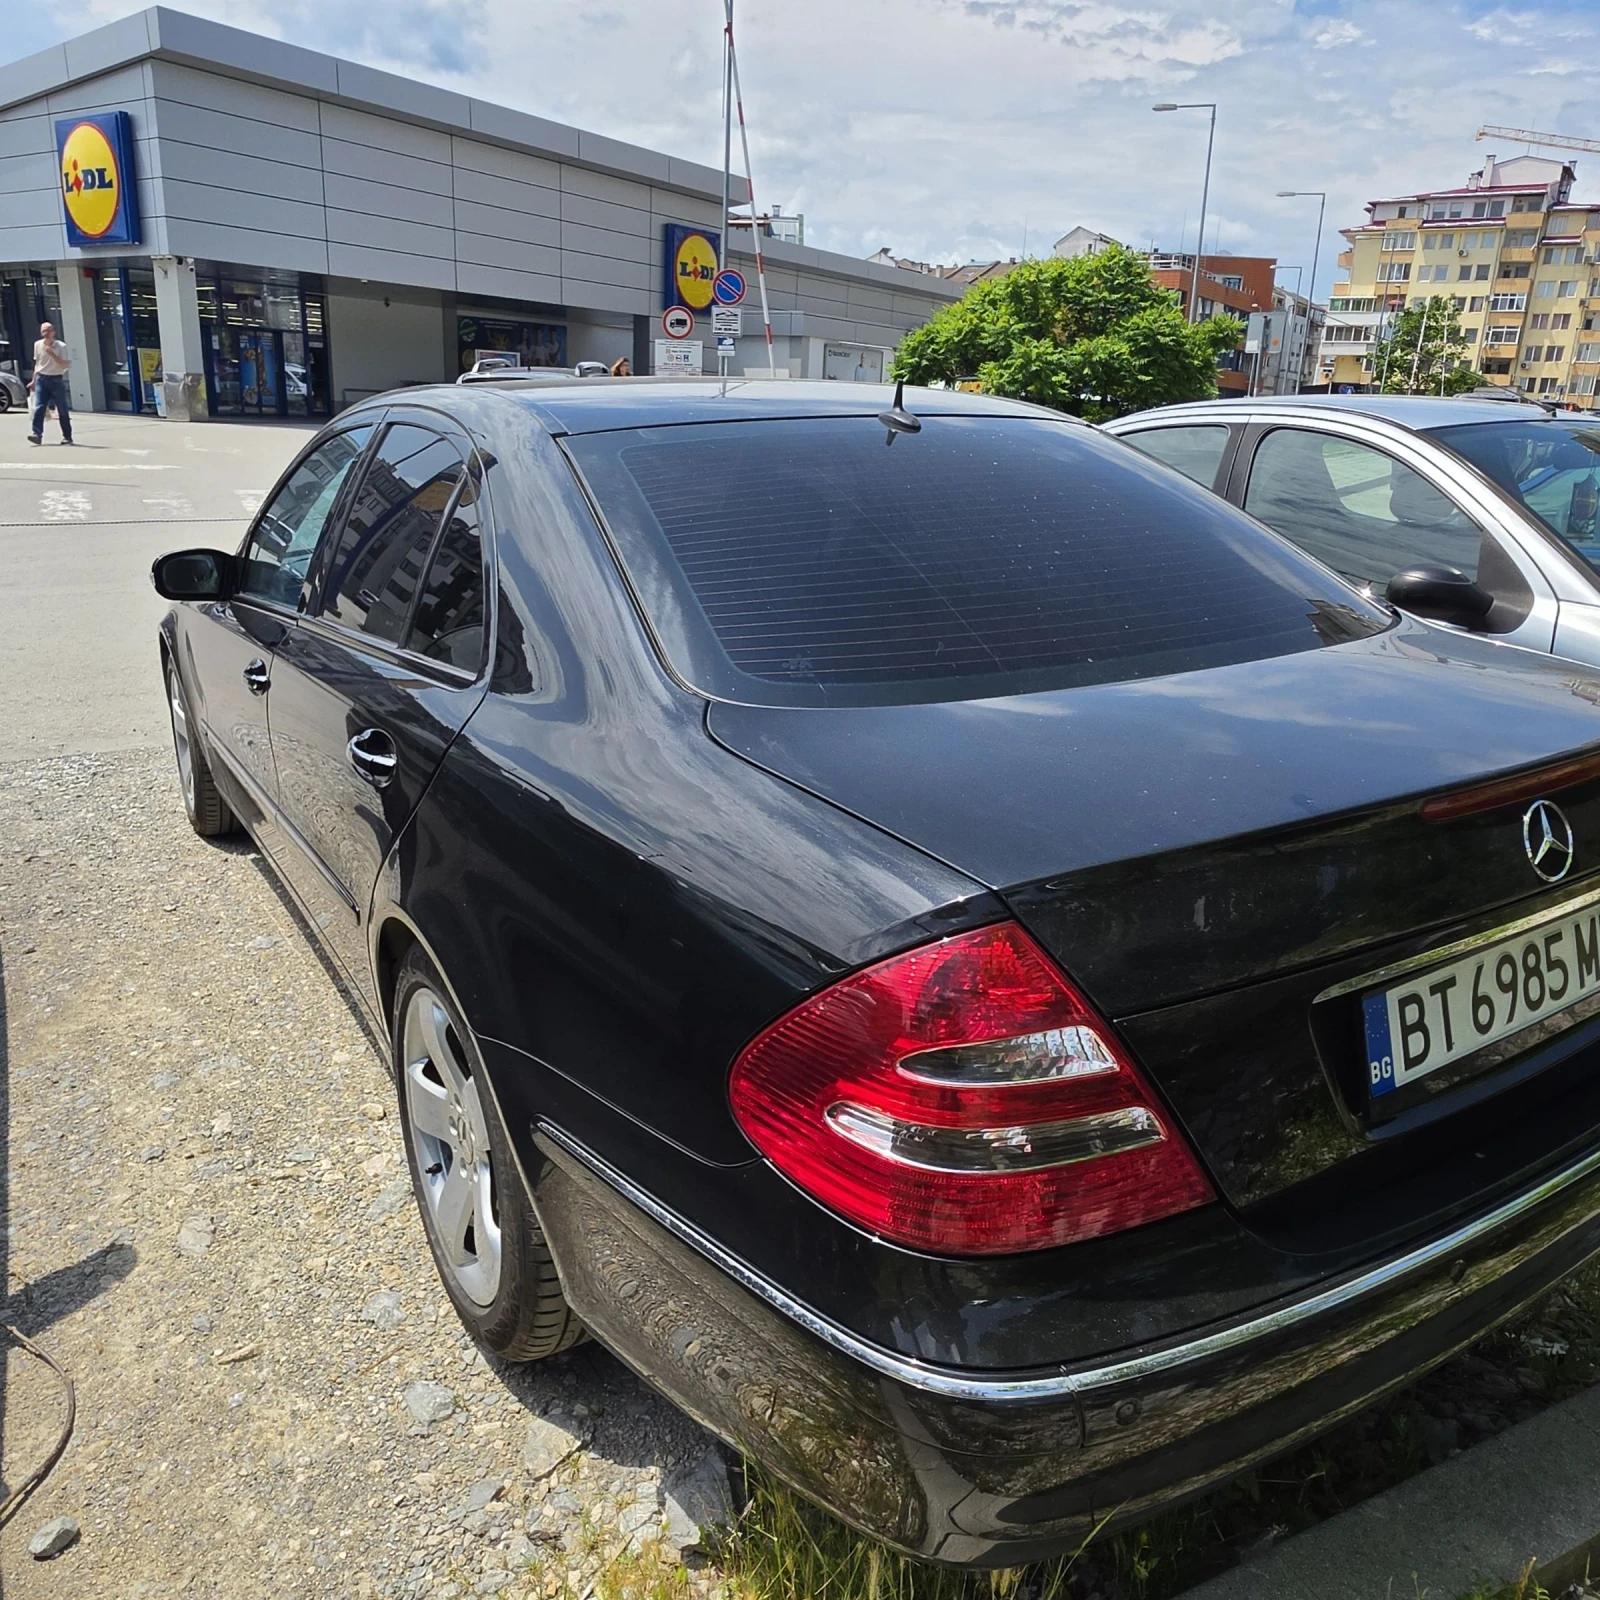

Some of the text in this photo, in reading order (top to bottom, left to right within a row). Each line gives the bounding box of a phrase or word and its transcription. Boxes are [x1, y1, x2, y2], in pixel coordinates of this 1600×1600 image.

[1397, 914, 1600, 1072] BT 6985 M
[1370, 1056, 1392, 1085] BG
